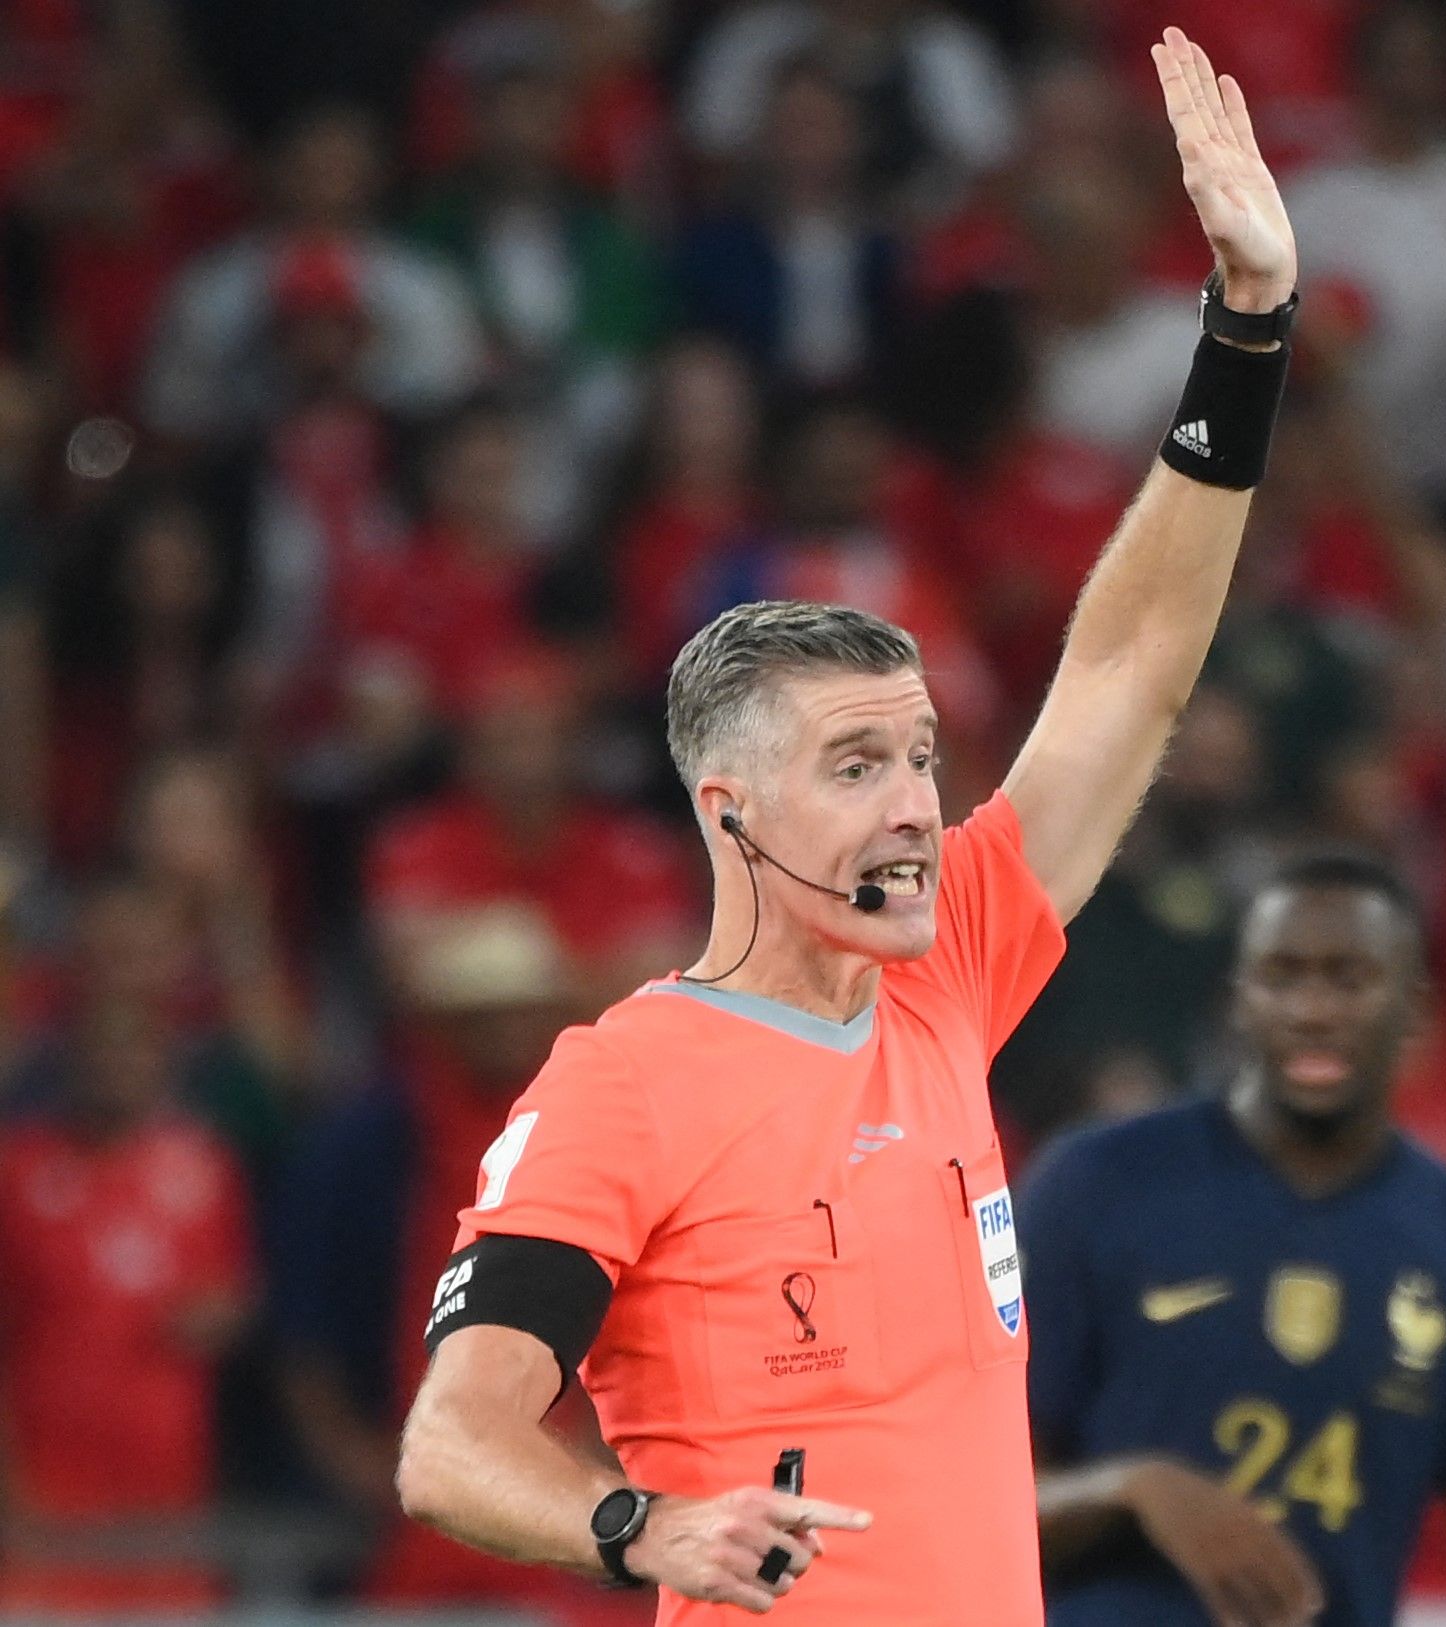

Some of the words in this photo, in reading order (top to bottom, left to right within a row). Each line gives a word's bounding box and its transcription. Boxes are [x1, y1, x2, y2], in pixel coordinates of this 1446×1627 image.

[1173, 429, 1212, 458] adidas
[980, 1198, 1011, 1240] FIFA
[432, 1258, 473, 1309] FA
[435, 1291, 466, 1324] ONE
[764, 1353, 788, 1365] FIFA
[789, 1350, 828, 1362] WORLD
[1213, 1401, 1363, 1532] 24
